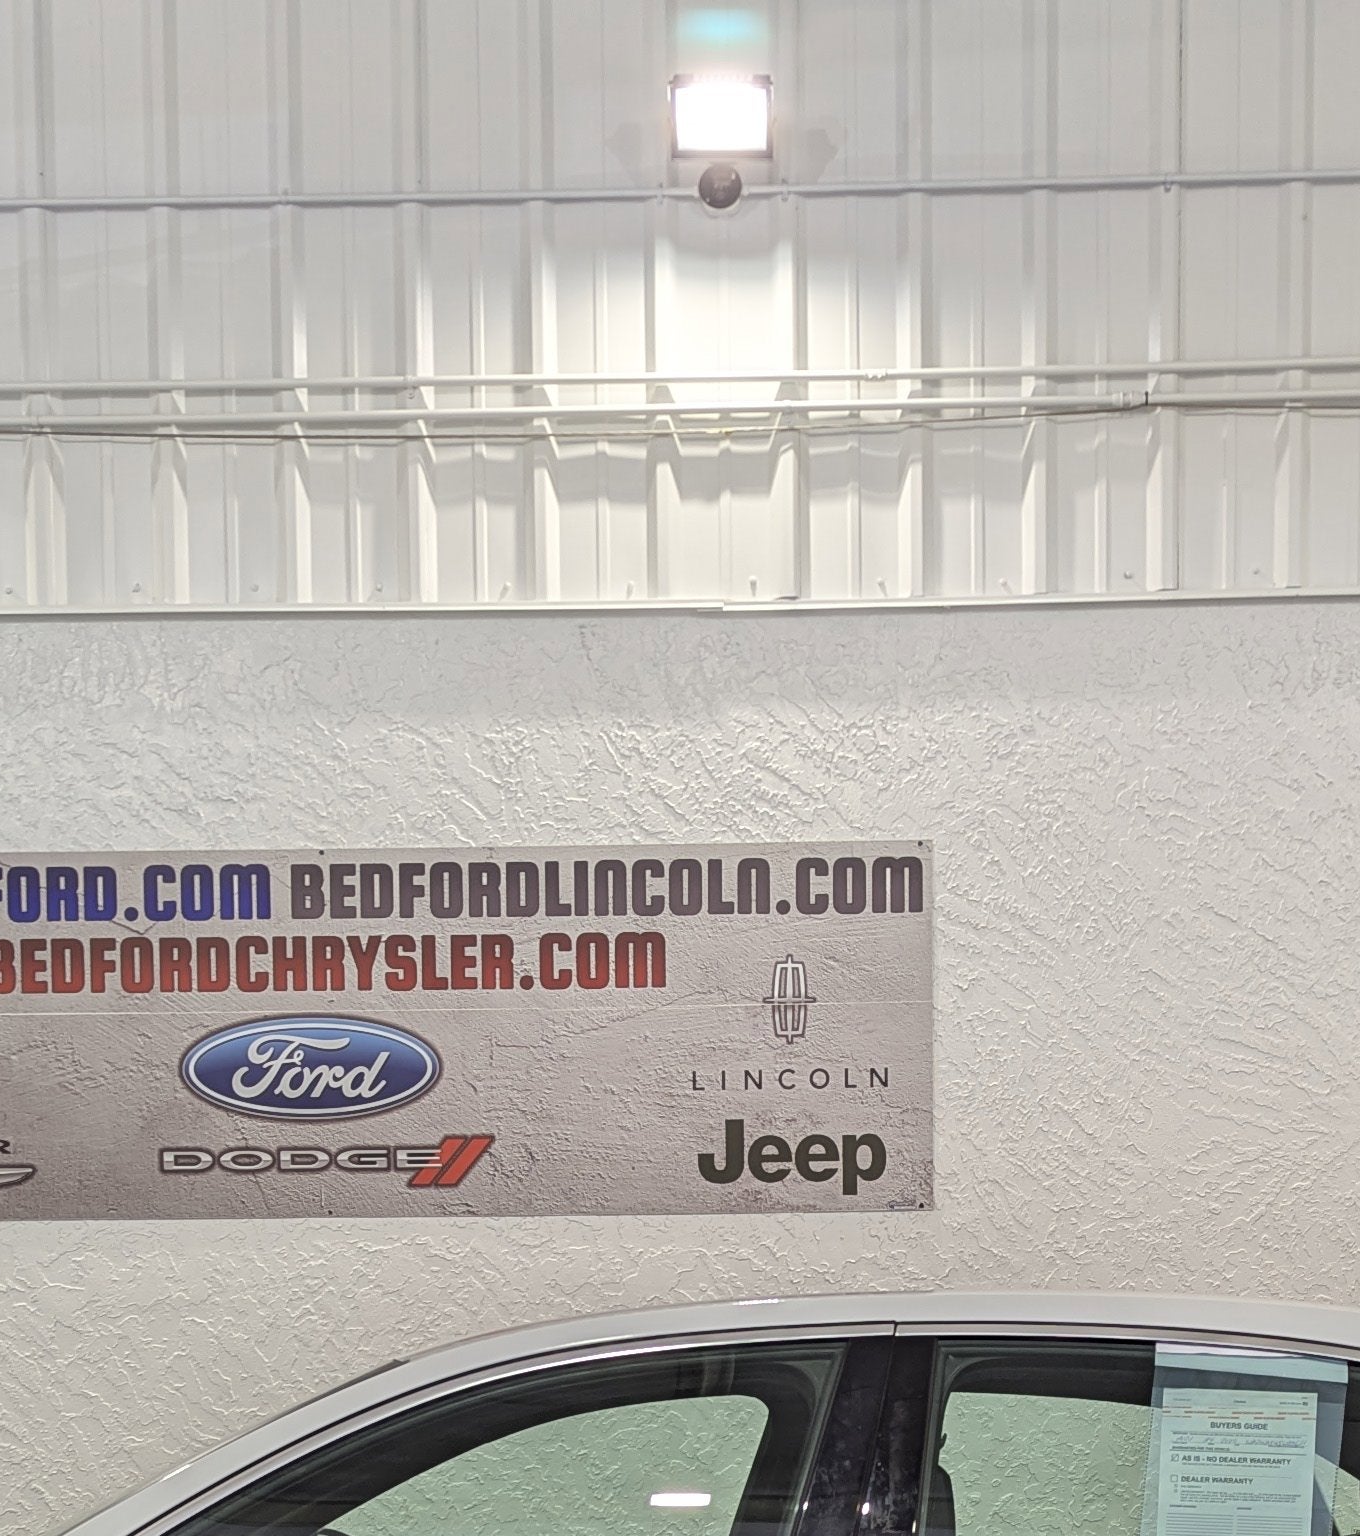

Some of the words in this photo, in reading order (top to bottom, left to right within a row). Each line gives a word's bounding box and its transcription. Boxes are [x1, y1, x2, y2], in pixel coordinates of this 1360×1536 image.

[290, 856, 924, 920] BEDFORDLINCOLN.COM
[231, 1034, 391, 1100] Ford
[691, 1067, 890, 1092] LINCOLN
[160, 1147, 442, 1173] DODGE
[697, 1118, 887, 1196] Jeep
[1210, 1421, 1242, 1429] BUYERS
[1244, 1422, 1269, 1430] GUIDE
[1181, 1454, 1192, 1462] AS
[1193, 1454, 1201, 1462] IS
[1206, 1455, 1217, 1463] NO
[1218, 1456, 1248, 1464] DEALER
[1249, 1457, 1292, 1465] WARRANTY
[1180, 1475, 1210, 1483] DEALER
[1211, 1476, 1254, 1485] WARRANTY
